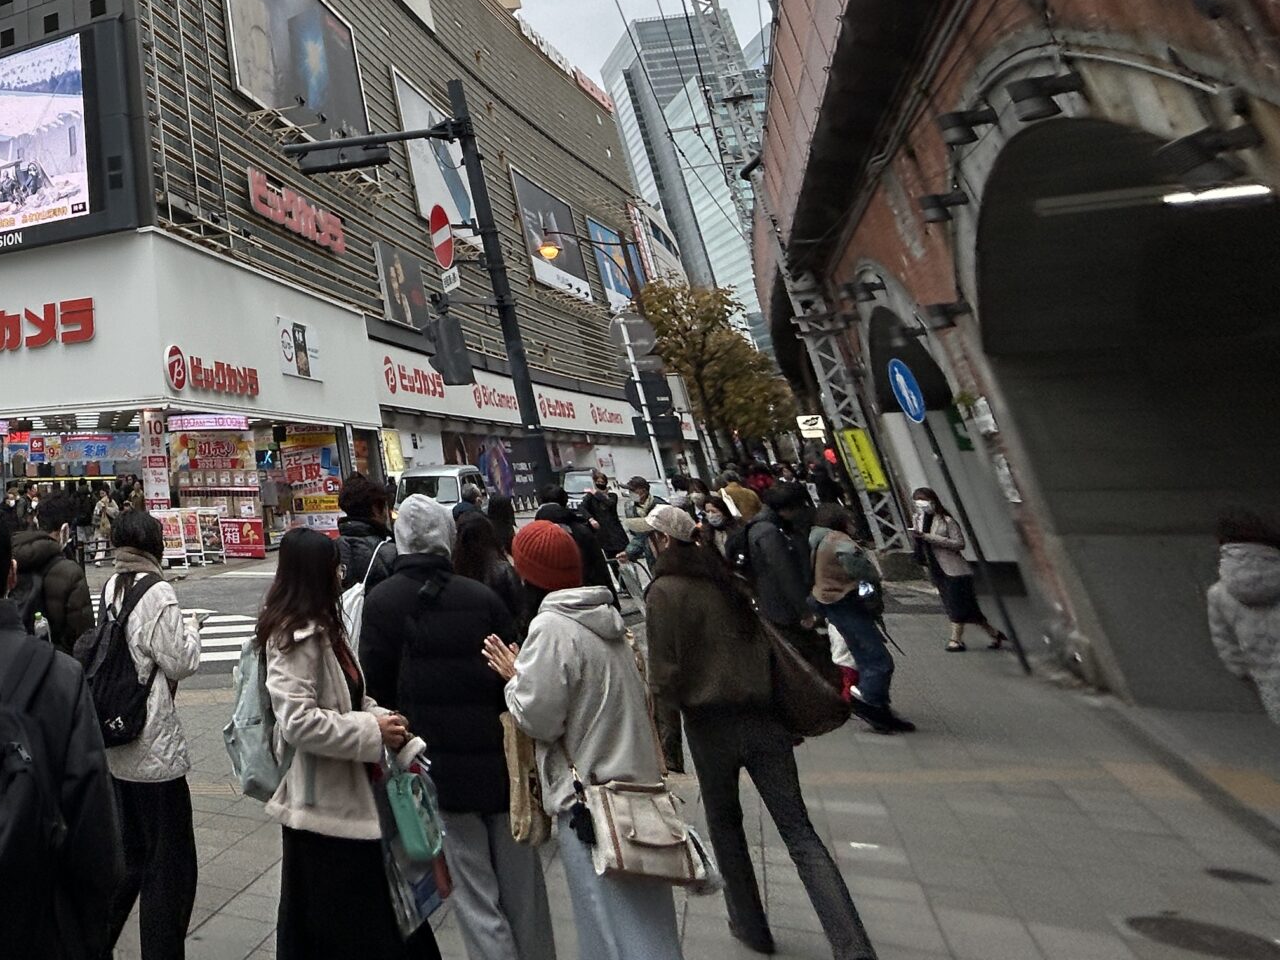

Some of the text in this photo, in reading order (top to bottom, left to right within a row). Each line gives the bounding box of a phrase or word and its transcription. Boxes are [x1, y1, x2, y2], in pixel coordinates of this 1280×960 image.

[247, 166, 346, 256] ビックカメラ
[190, 355, 260, 397] ビックカメラ
[398, 364, 445, 399] ビックカメラ
[545, 396, 576, 420] ビックカメラ
[147, 420, 163, 435] 10
[198, 440, 236, 457] 初売り
[286, 454, 320, 467] スピード
[287, 462, 322, 484] 買取
